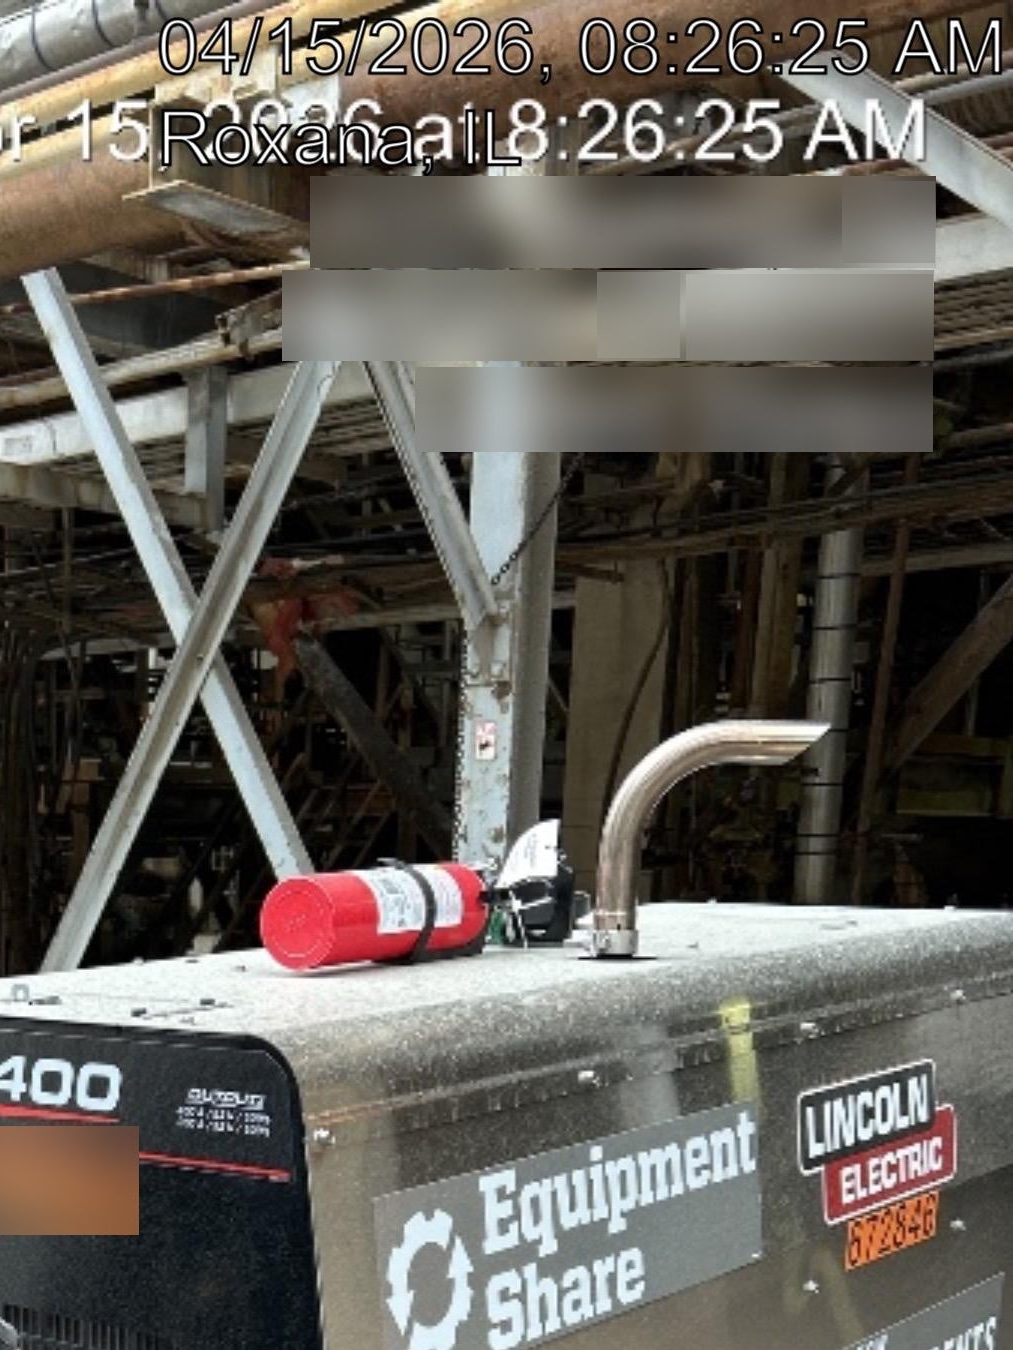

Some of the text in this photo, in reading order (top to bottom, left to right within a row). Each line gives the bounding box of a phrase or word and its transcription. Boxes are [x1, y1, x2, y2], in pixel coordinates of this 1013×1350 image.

[805, 1073, 930, 1159] LINCOLN
[478, 1109, 757, 1258] Equipment
[840, 1135, 944, 1206] ELECTRIC
